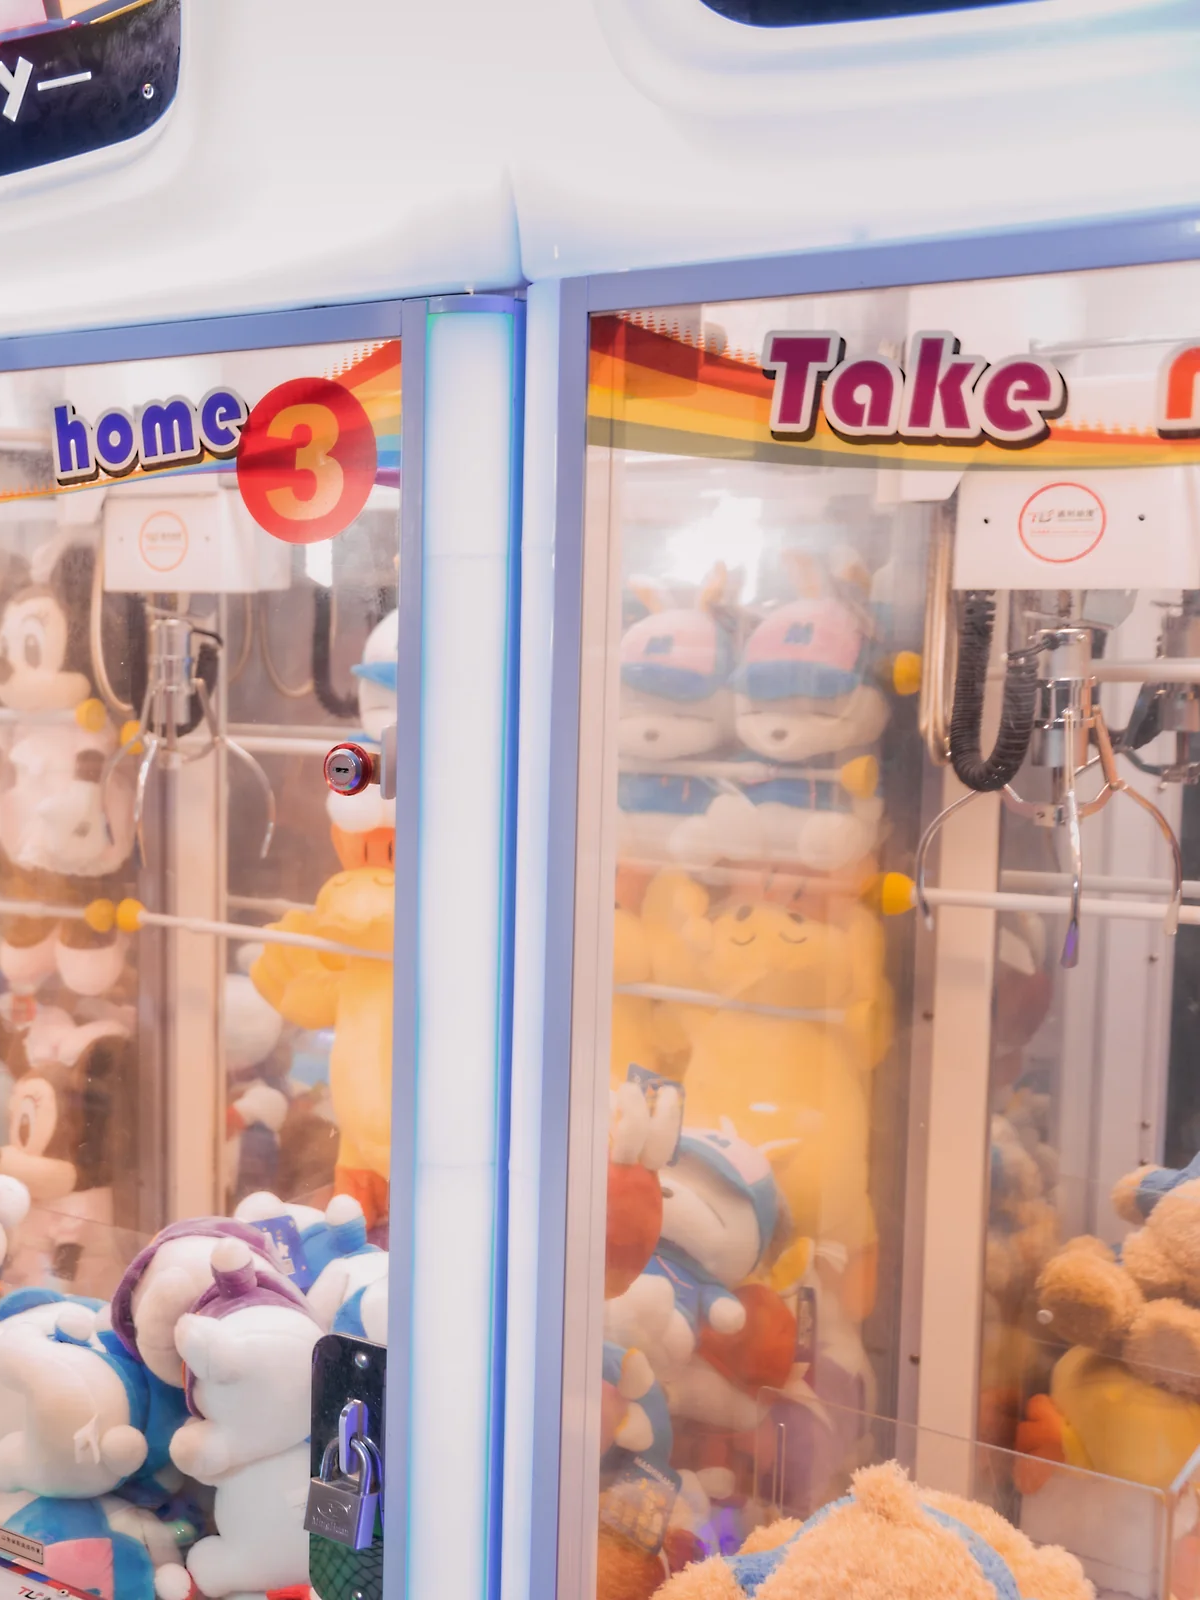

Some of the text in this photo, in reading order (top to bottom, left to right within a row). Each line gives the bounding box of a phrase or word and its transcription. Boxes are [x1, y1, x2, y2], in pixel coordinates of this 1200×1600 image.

[53, 388, 247, 478] home
[766, 333, 1056, 436] Take
[263, 403, 345, 522] 3
